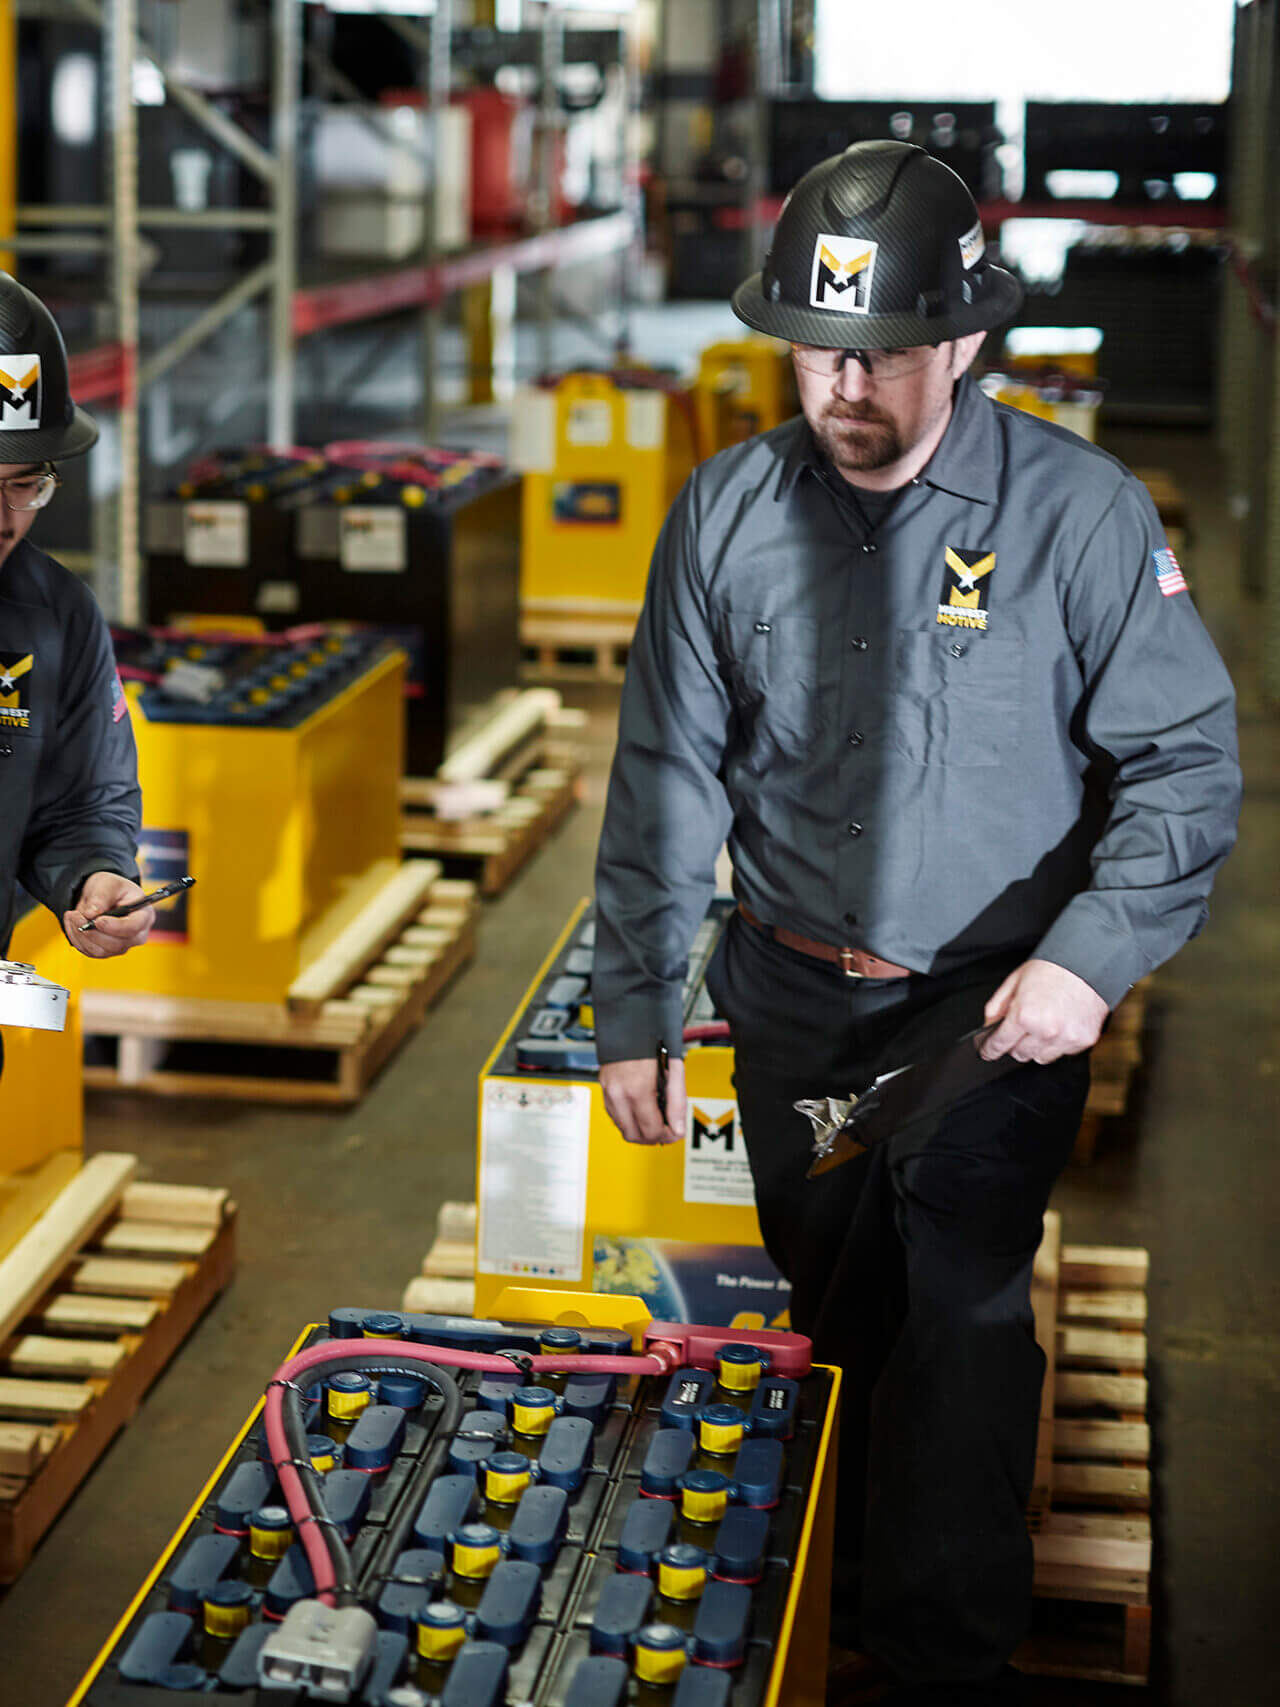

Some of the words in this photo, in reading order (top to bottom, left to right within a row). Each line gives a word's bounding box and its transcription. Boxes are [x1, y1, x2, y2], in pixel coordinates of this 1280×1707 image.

[936, 613, 989, 630] MOTIVE
[716, 1273, 737, 1288] The
[739, 1275, 775, 1290] Power
